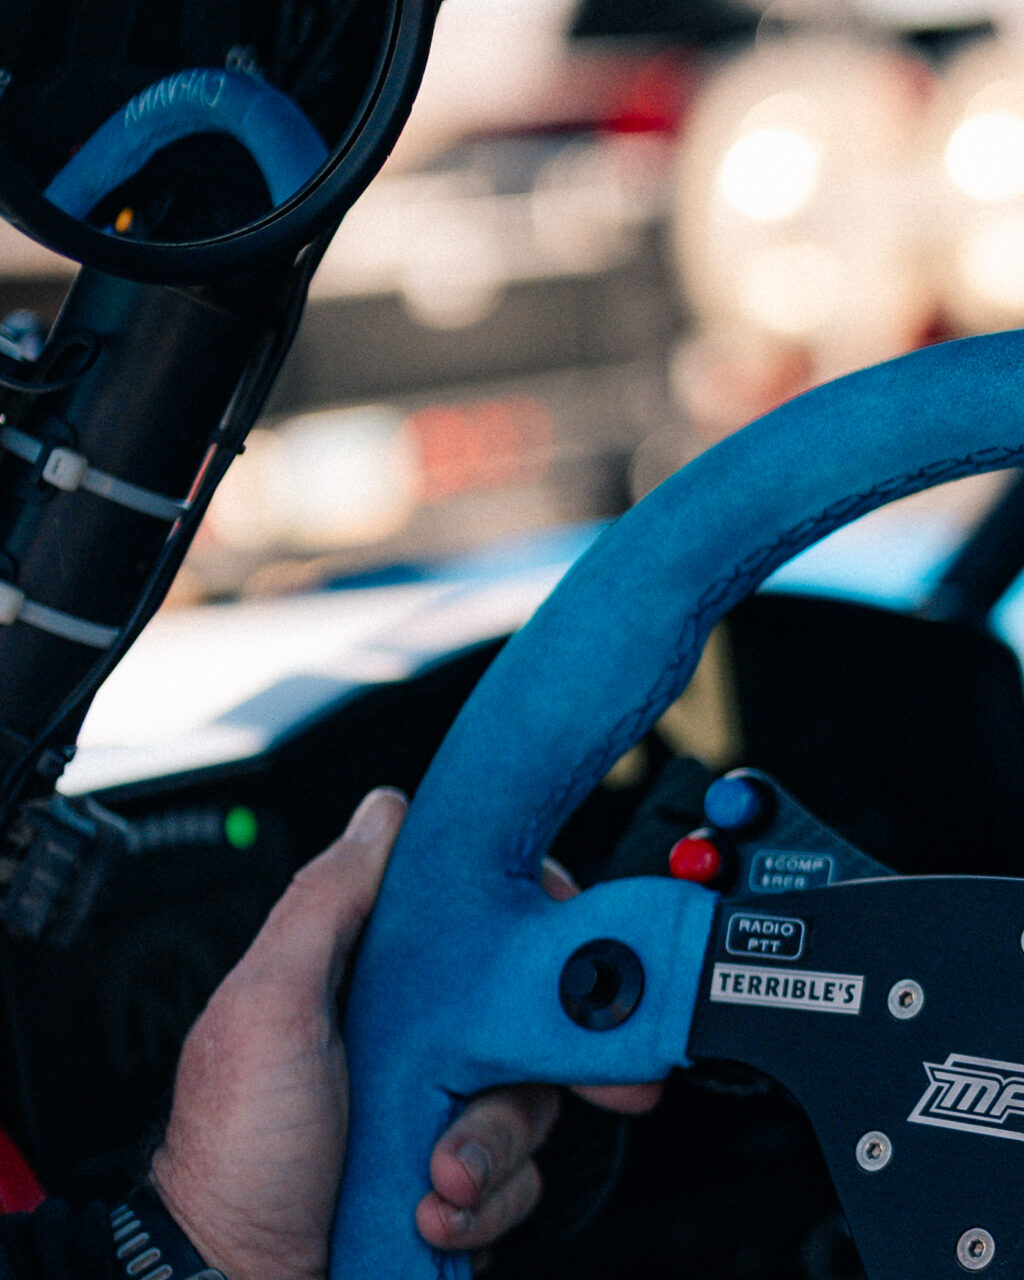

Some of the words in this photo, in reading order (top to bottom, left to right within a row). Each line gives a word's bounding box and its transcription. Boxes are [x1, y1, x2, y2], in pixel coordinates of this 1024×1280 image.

[738, 918, 795, 937] RADIO
[747, 938, 780, 953] PTT
[719, 972, 857, 1004] TERRIBLE'S
